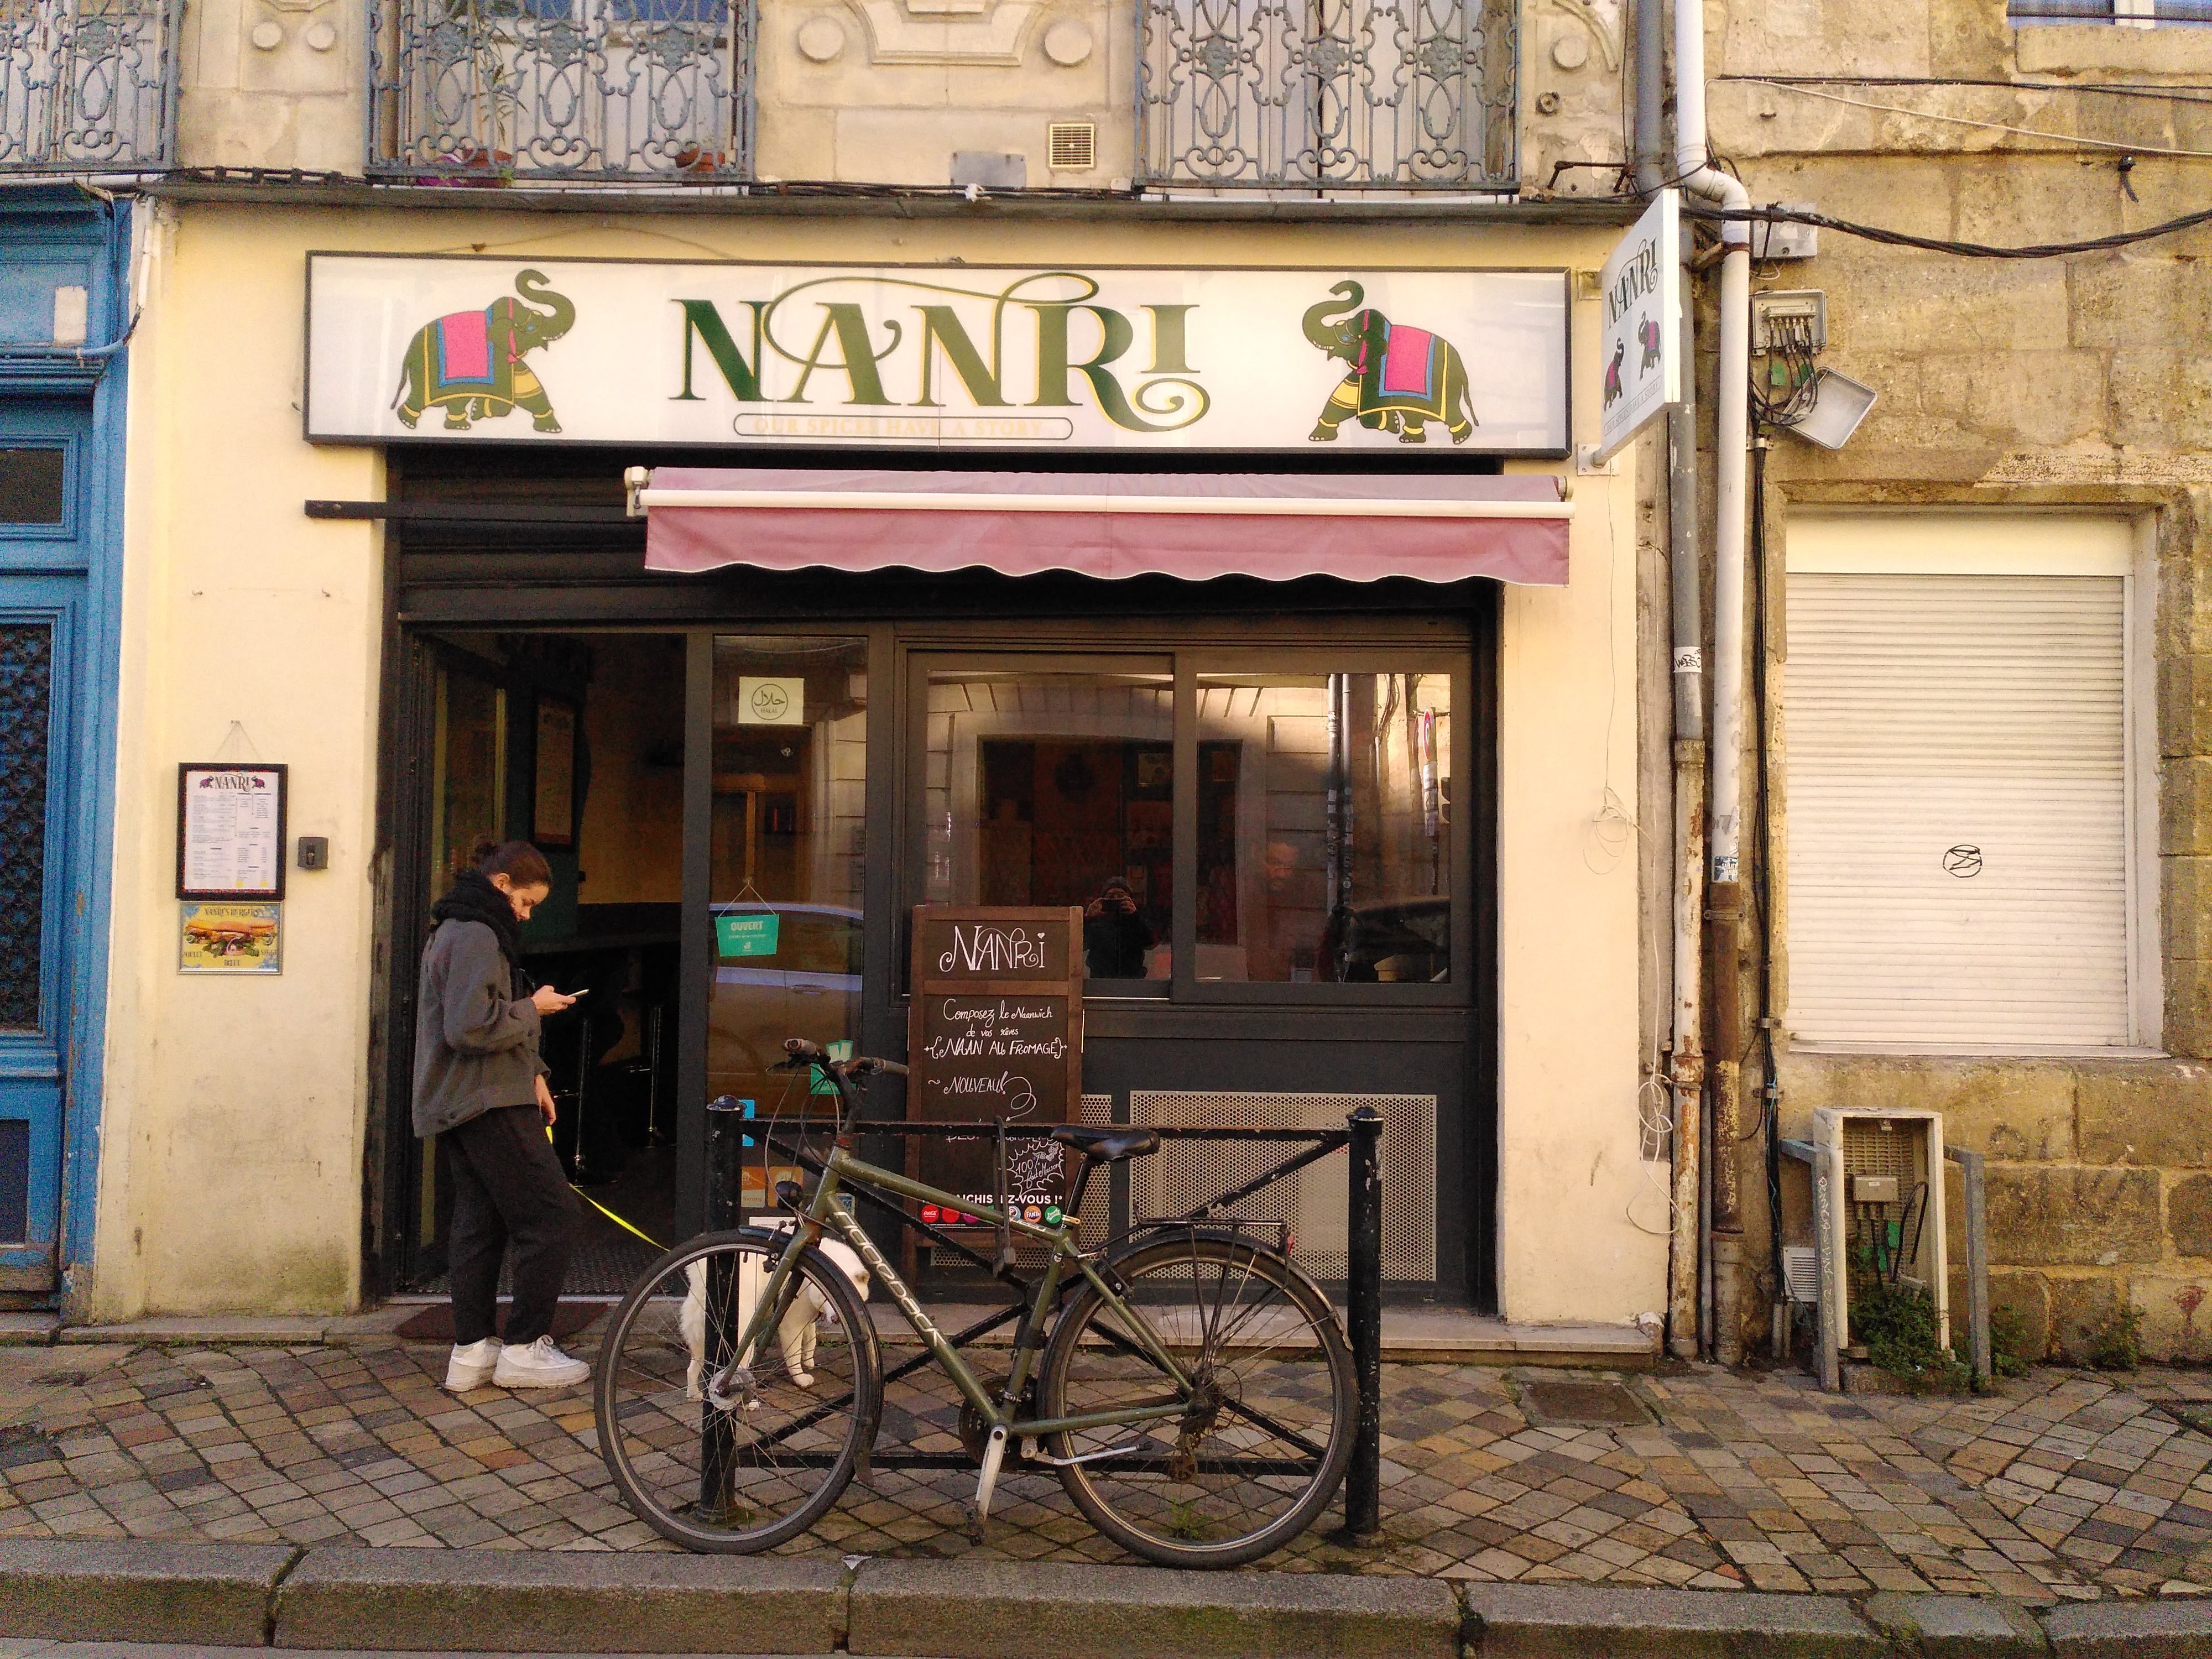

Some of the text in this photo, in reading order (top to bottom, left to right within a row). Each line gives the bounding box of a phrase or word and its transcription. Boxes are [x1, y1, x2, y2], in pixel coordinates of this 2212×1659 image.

[1608, 237, 1658, 330] NANRI
[669, 272, 1211, 432] NANRI
[807, 419, 878, 435] SPICES
[886, 420, 943, 436] HAVE
[954, 420, 968, 436] A
[974, 420, 1043, 436] STORY
[215, 773, 251, 792] NANRI
[731, 921, 763, 931] OUVERT
[943, 999, 1053, 1027] Composez le Naanwich
[966, 1024, 975, 1037] de
[1000, 1027, 1019, 1036] rêves
[1015, 1154, 1040, 1174] 100%
